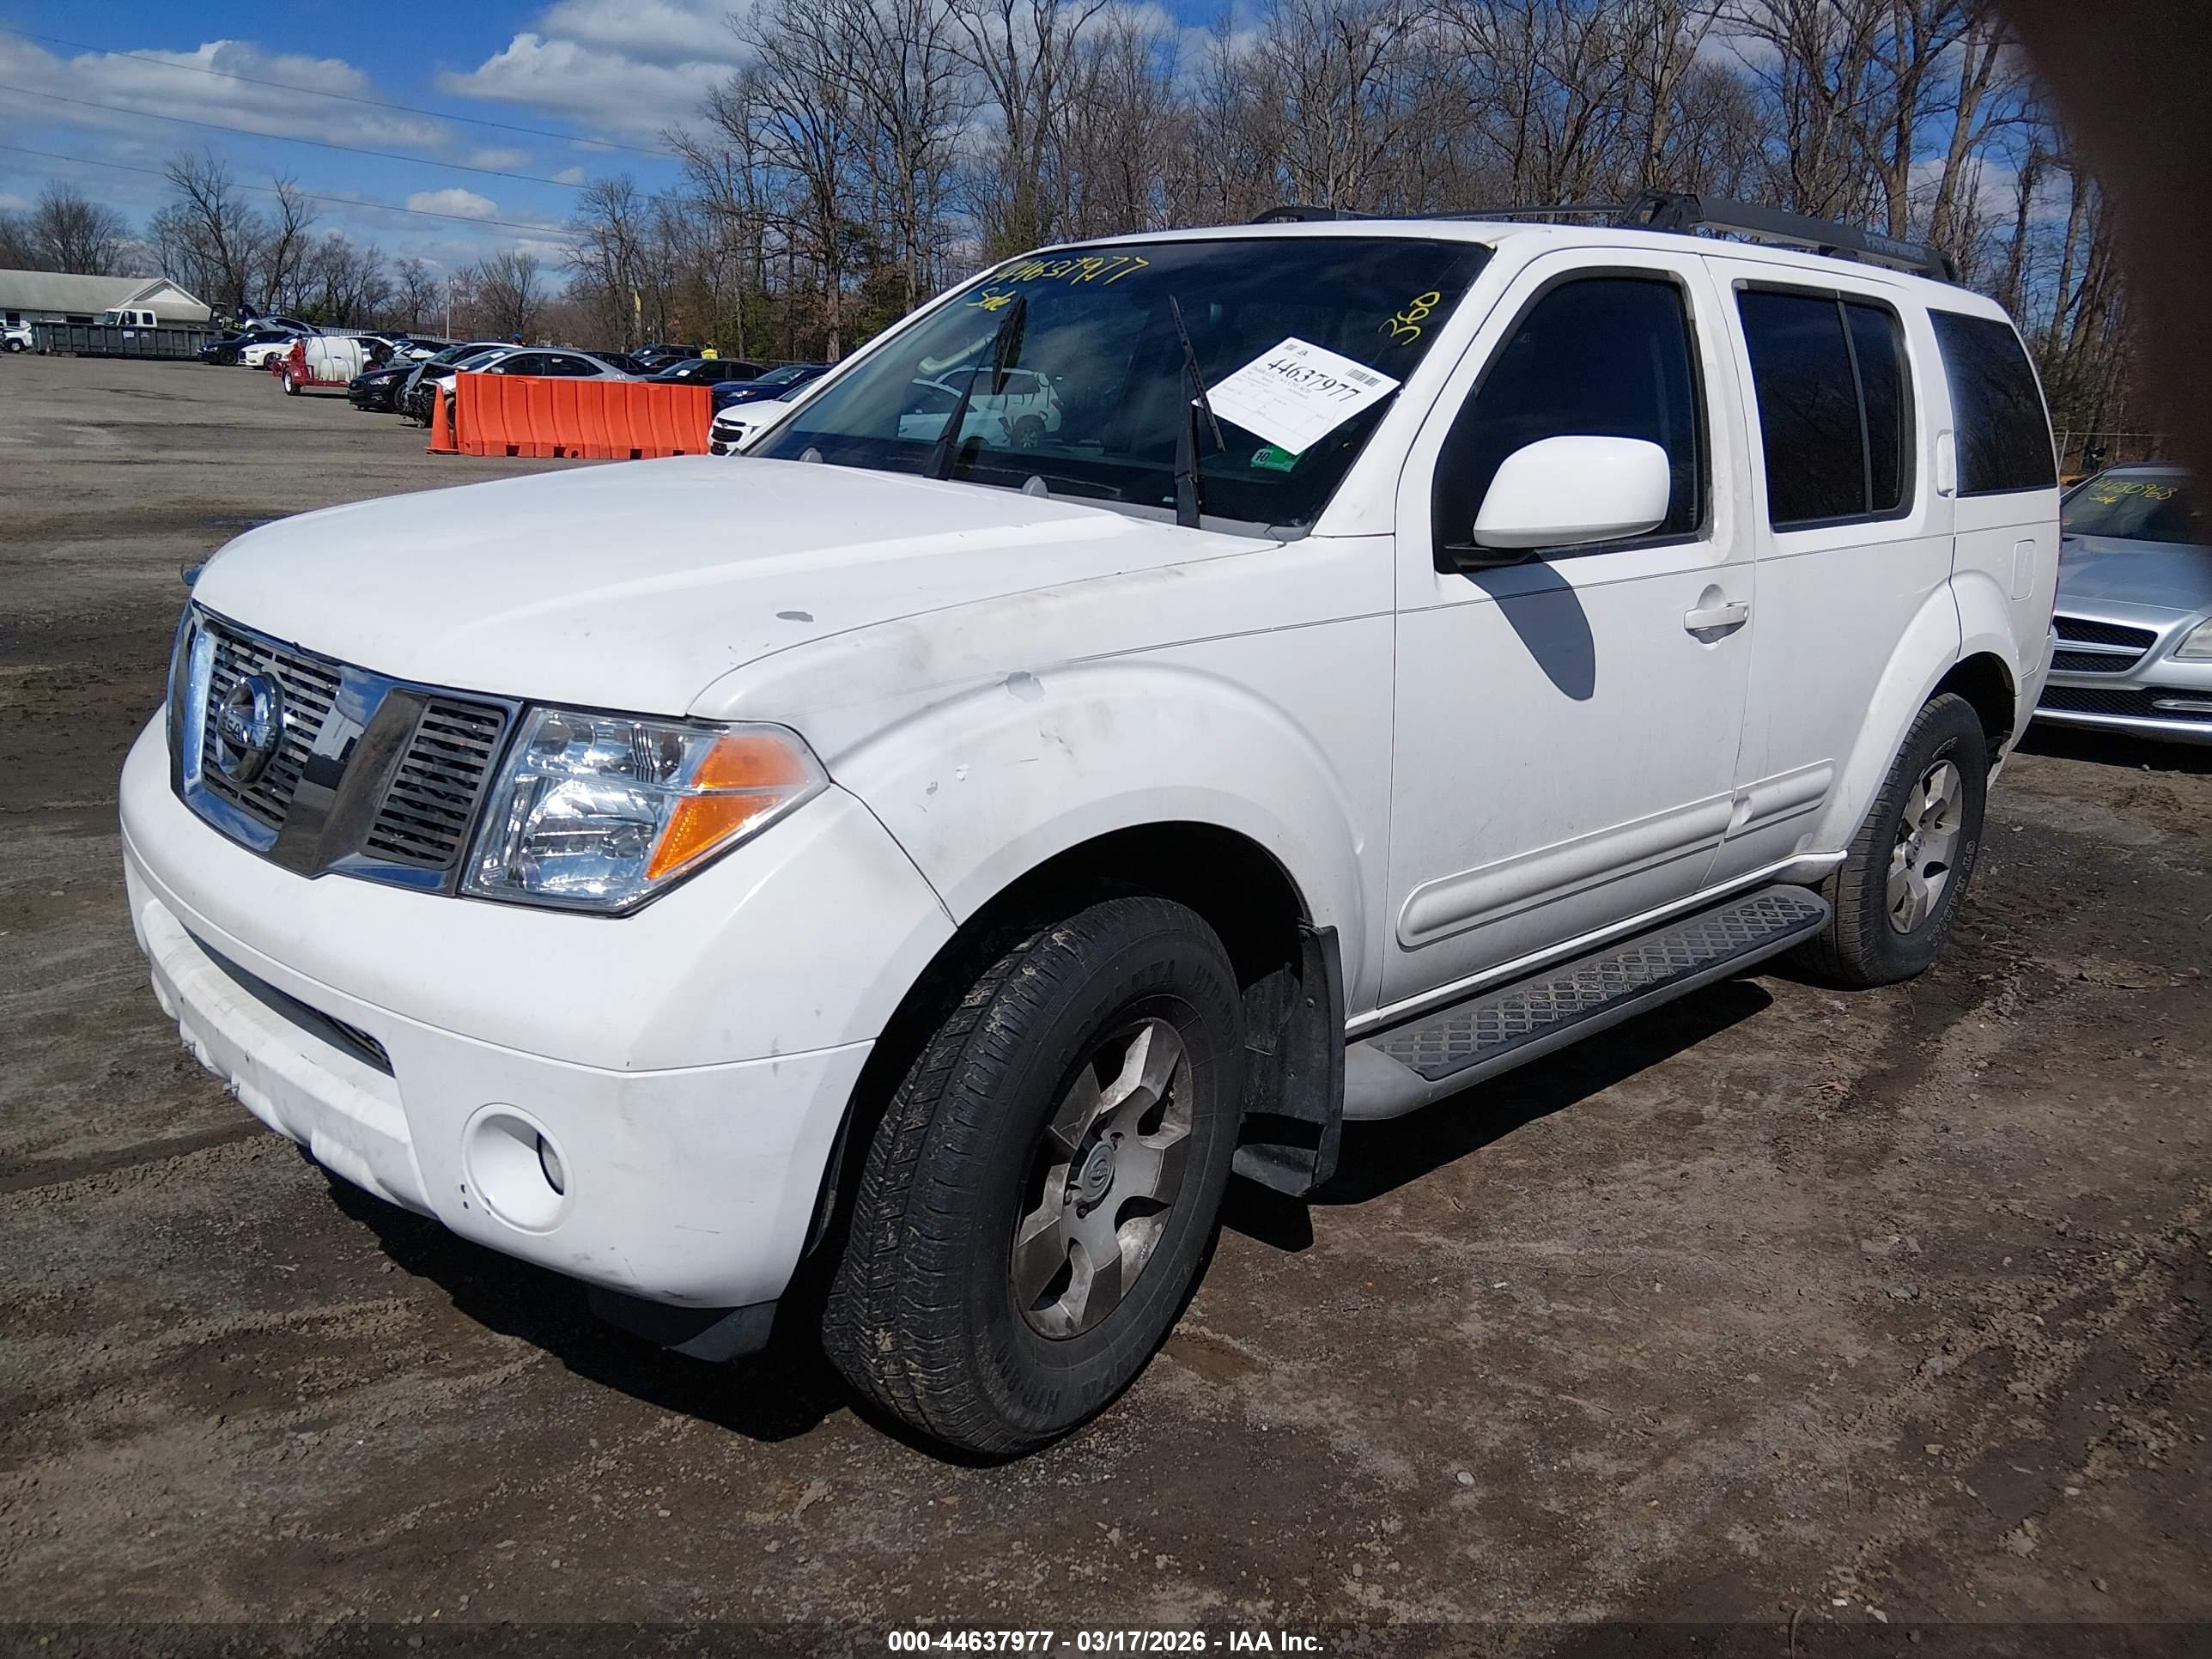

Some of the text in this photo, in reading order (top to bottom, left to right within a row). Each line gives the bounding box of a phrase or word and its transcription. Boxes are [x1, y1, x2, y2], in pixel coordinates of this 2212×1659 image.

[1377, 291, 1441, 346] 360
[1267, 358, 1362, 403] 44637977
[1255, 452, 1271, 462] 10
